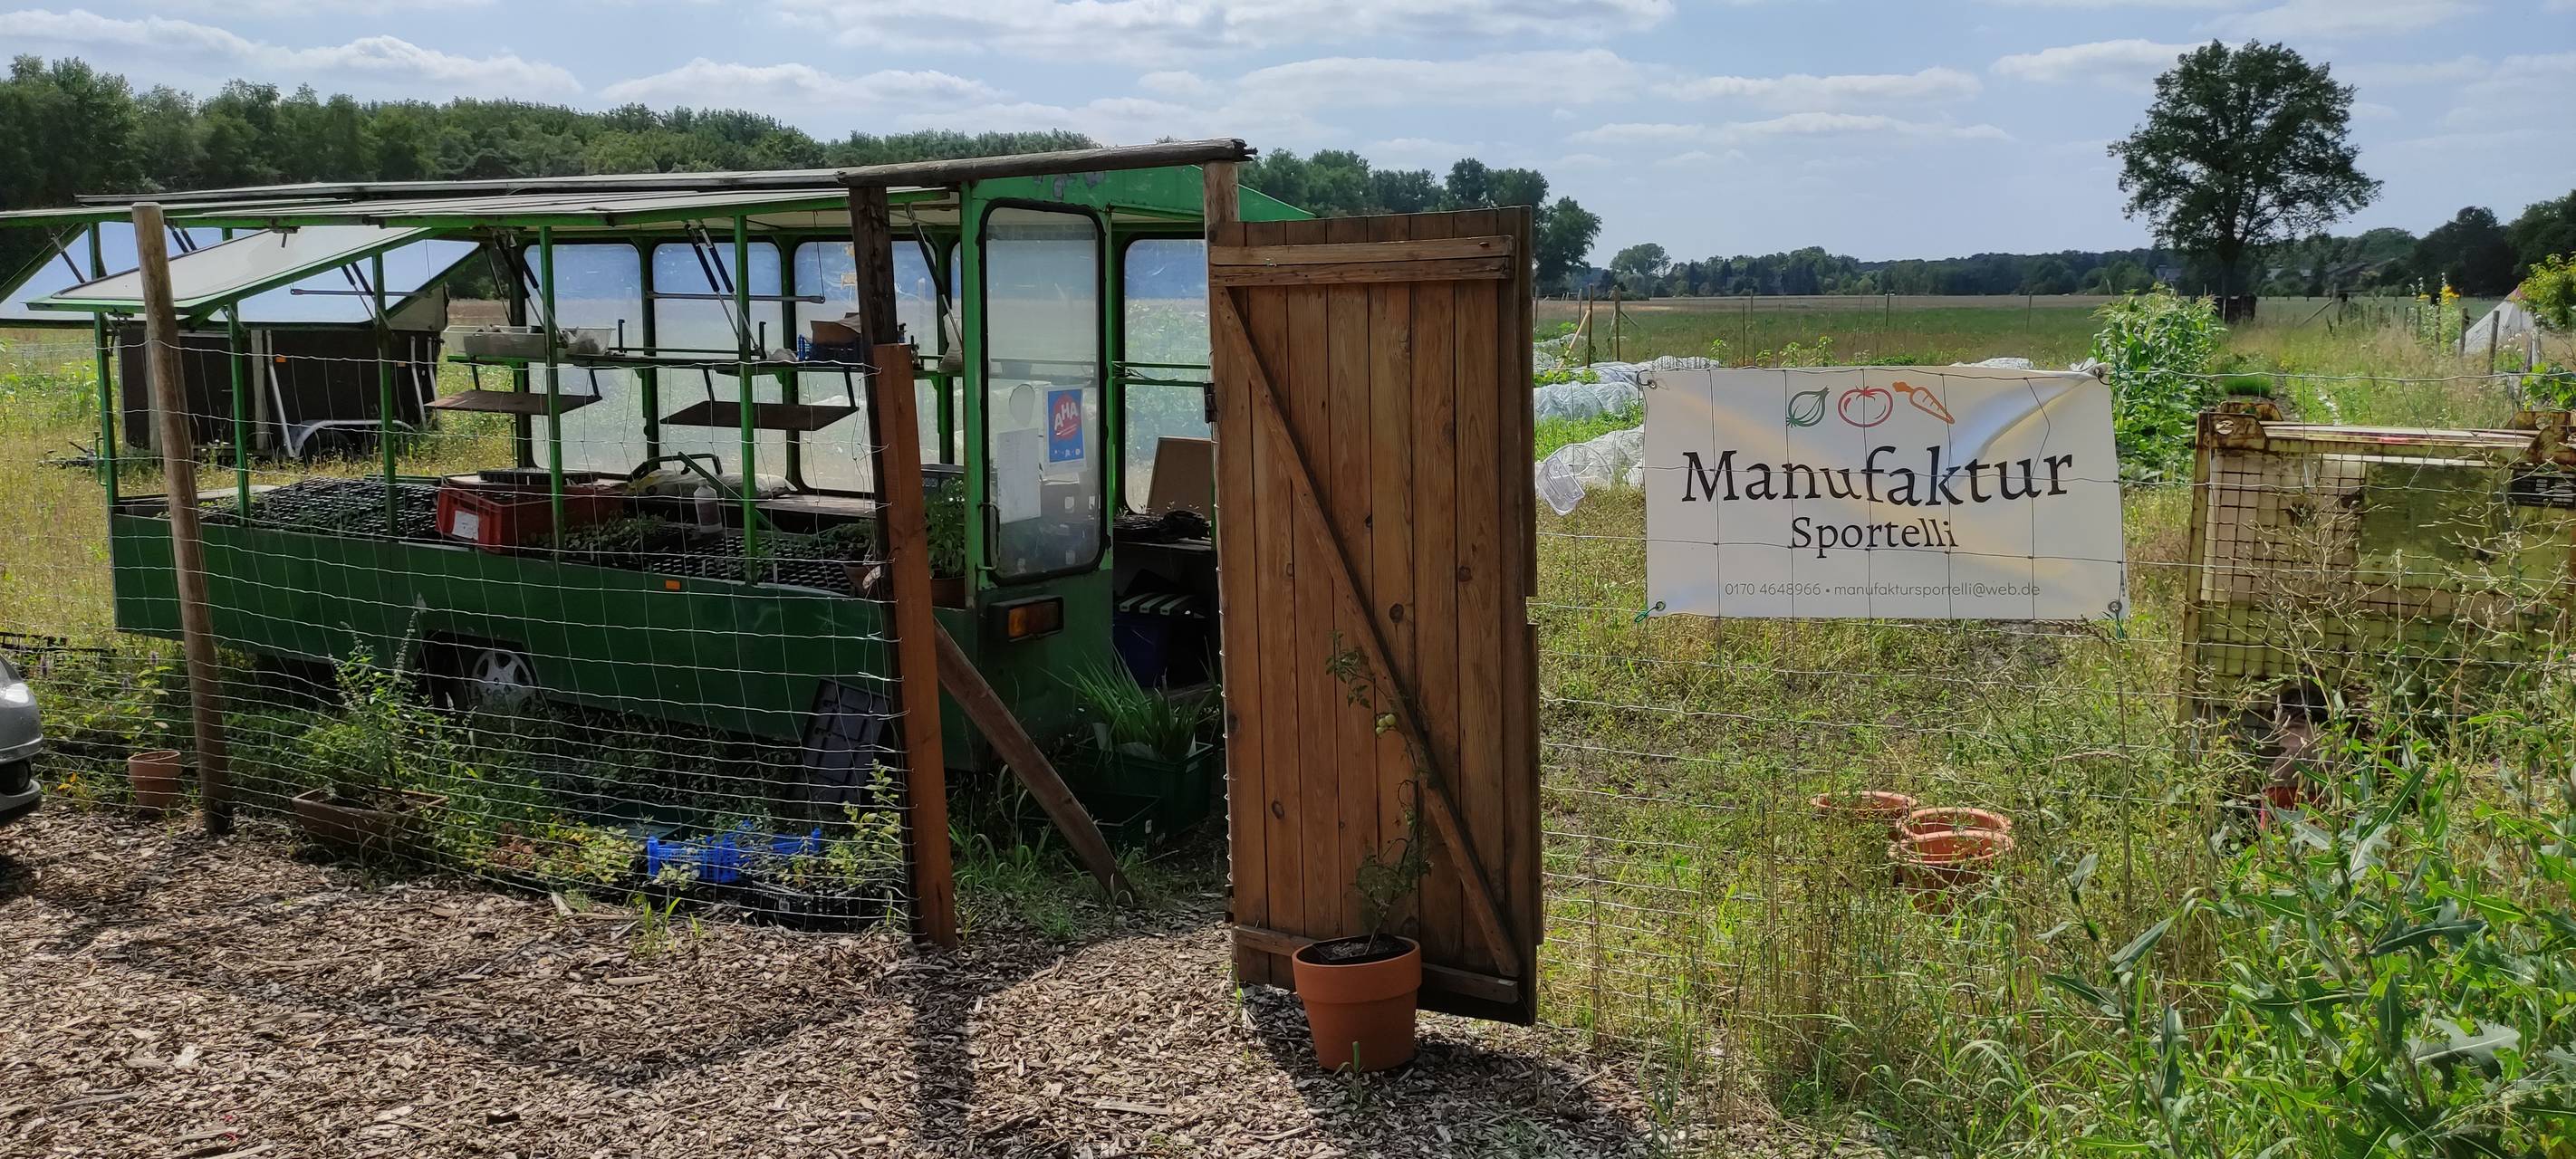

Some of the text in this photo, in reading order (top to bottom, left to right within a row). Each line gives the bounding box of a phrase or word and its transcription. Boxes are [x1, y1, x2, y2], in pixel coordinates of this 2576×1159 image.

[1053, 401, 1080, 431] AHA
[1681, 445, 2073, 507] Manufaktur
[1792, 516, 1959, 560] Sportelli
[1724, 581, 2041, 599] 0170 4648966 manufaktursportelli@web.de
